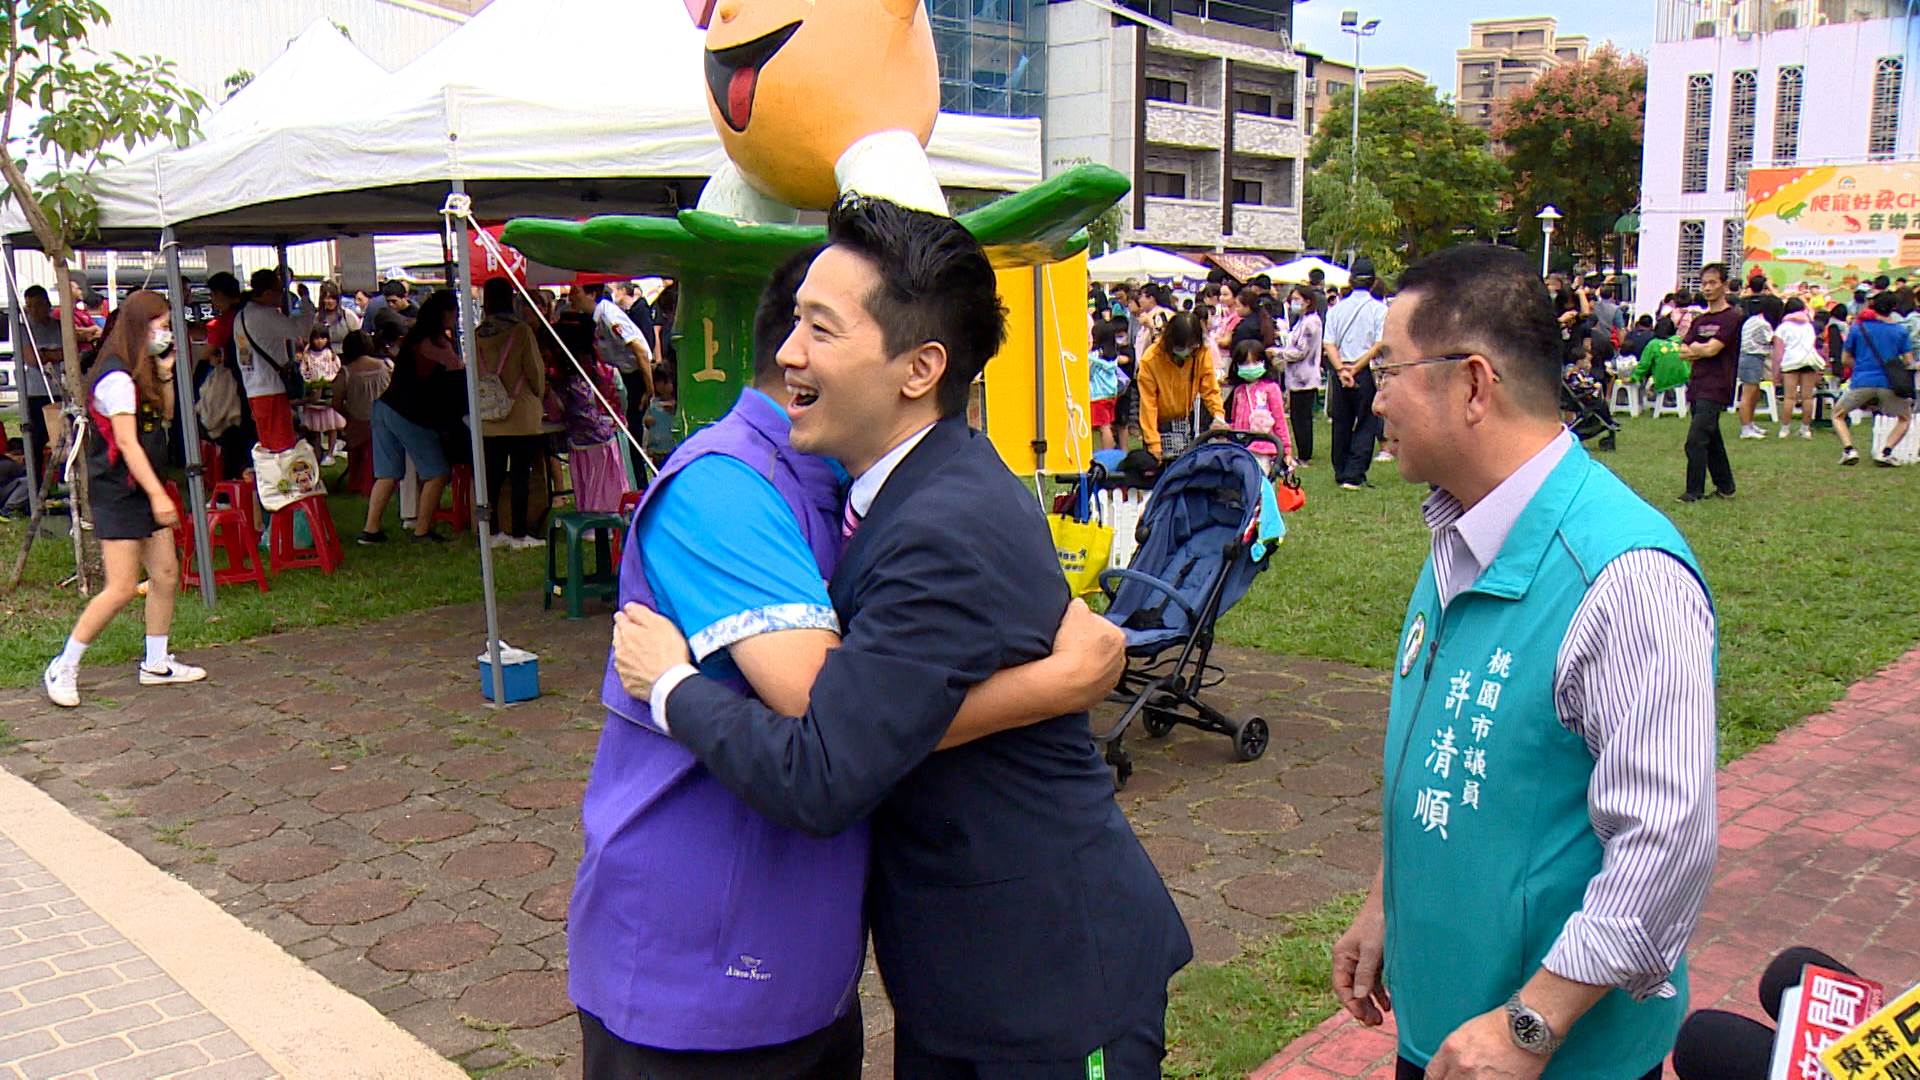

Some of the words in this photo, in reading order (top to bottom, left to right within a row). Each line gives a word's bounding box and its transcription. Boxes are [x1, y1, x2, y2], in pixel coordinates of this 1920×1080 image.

[1413, 669, 1473, 841] 許清順
[1461, 647, 1513, 810] 桃園市議員
[1833, 1025, 1900, 1080] 東森
